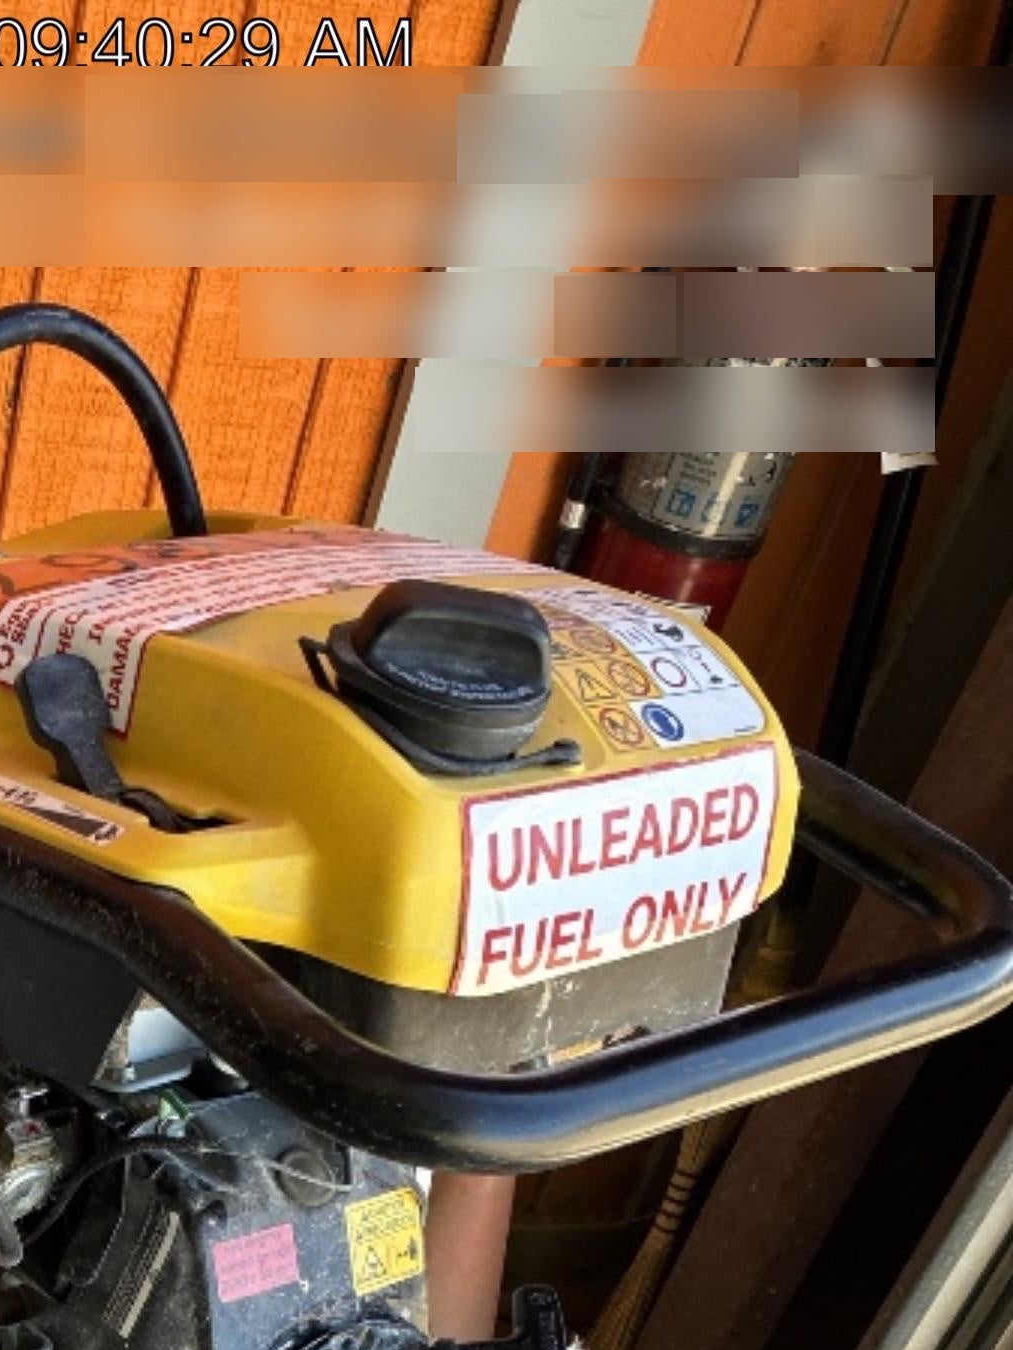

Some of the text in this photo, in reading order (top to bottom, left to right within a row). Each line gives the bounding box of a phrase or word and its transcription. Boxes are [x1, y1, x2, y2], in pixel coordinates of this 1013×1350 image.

[485, 782, 760, 892] UNLEADED
[475, 870, 748, 988] FUEL ONLY
